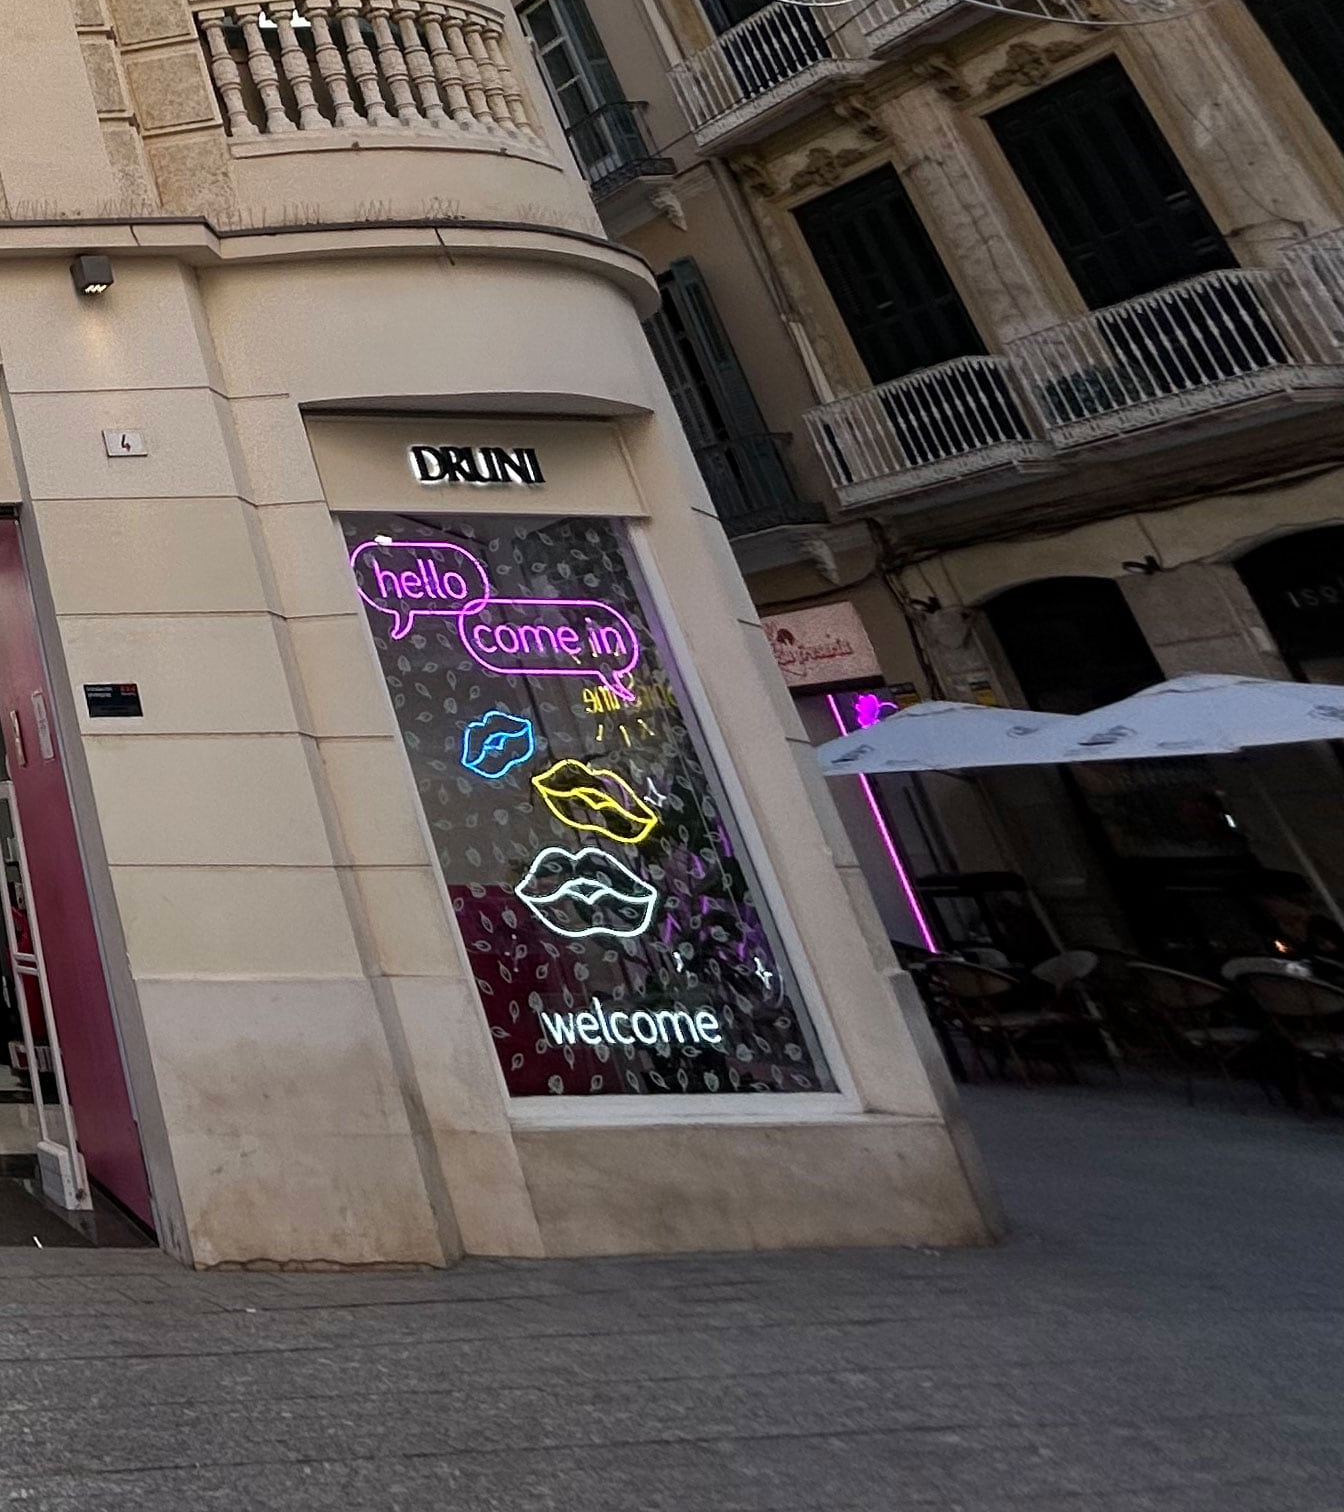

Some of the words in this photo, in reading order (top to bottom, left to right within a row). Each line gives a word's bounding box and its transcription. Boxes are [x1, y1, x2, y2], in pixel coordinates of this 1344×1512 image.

[121, 433, 131, 453] 4
[411, 445, 547, 484] DRUNI
[372, 558, 468, 599] hello
[472, 623, 583, 654] come
[583, 616, 629, 656] in
[540, 995, 723, 1045] welcome
